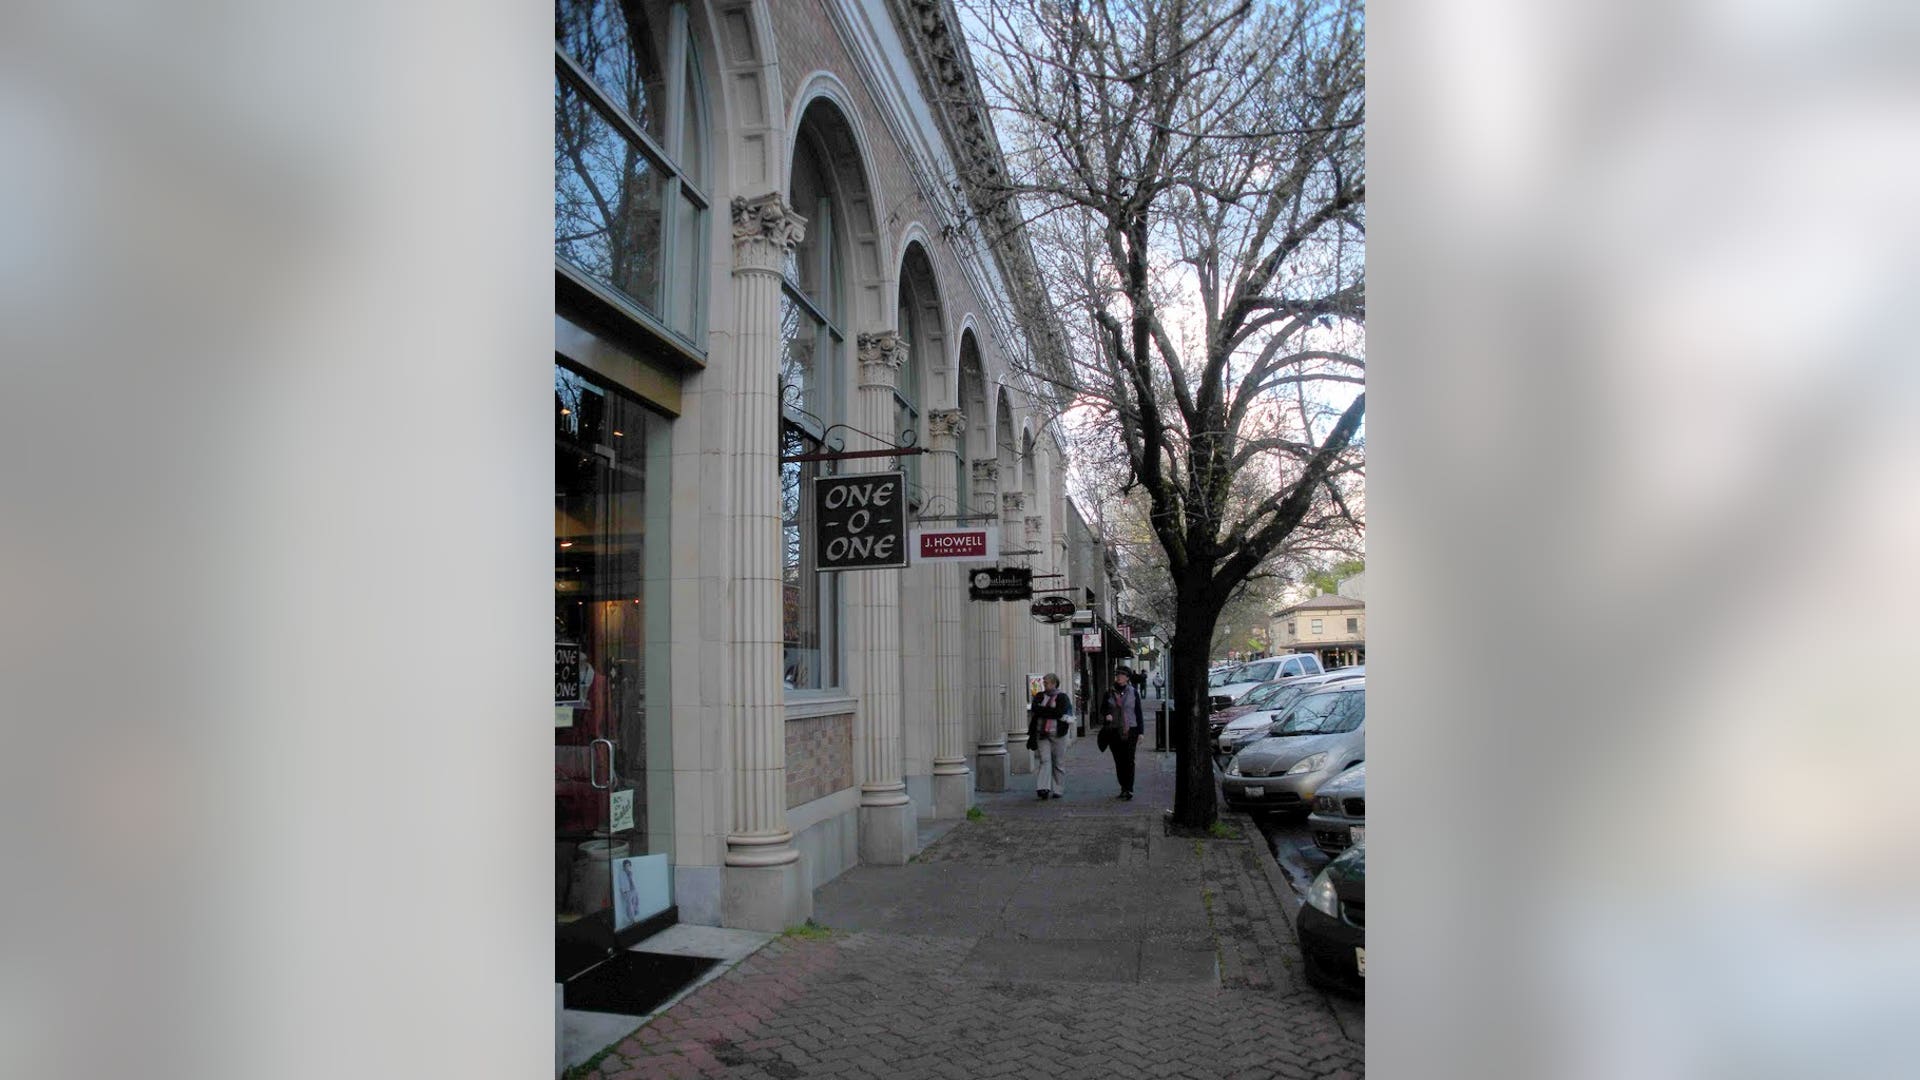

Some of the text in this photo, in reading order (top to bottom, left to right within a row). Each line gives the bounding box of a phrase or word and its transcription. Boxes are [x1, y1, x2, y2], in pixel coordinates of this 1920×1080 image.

[825, 482, 895, 510] ONE
[826, 534, 896, 561] ONE
[555, 649, 578, 665] ONE
[555, 682, 578, 698] ONE
